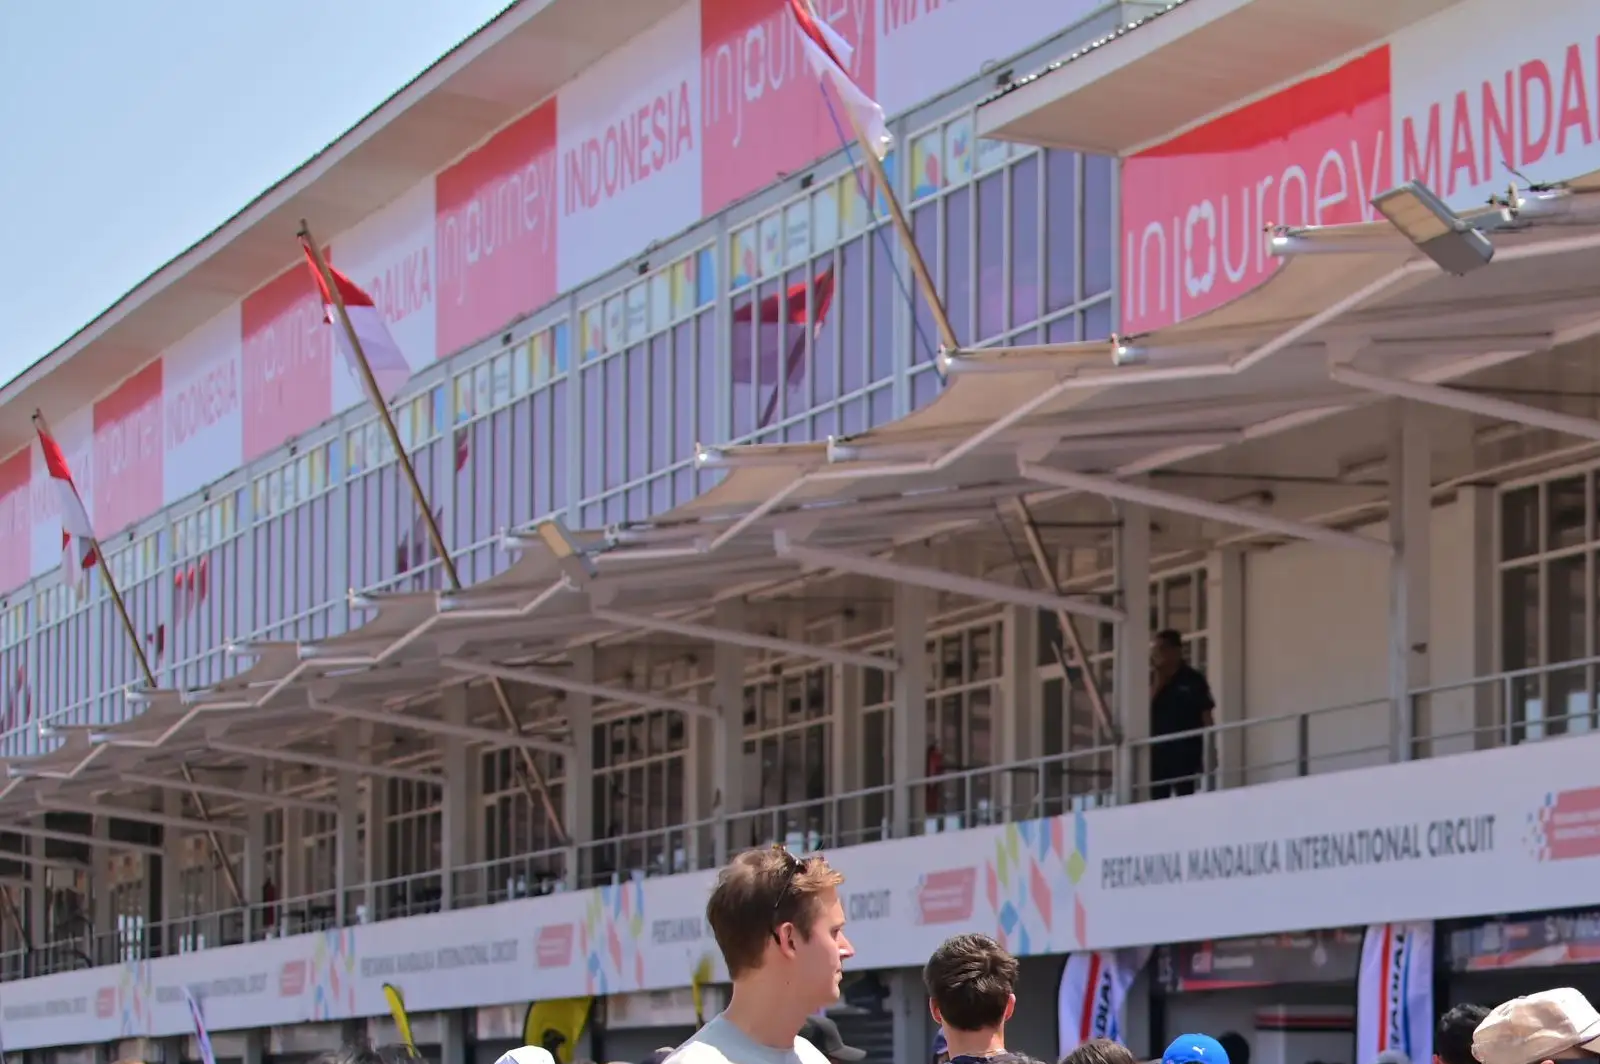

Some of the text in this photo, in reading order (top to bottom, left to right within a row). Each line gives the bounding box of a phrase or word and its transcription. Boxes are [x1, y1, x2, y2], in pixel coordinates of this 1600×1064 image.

[564, 81, 693, 216] INDONESIA
[1101, 814, 1496, 890] PERTAMINA MANDALIKA INTERNATIONAL CIRCUIT
